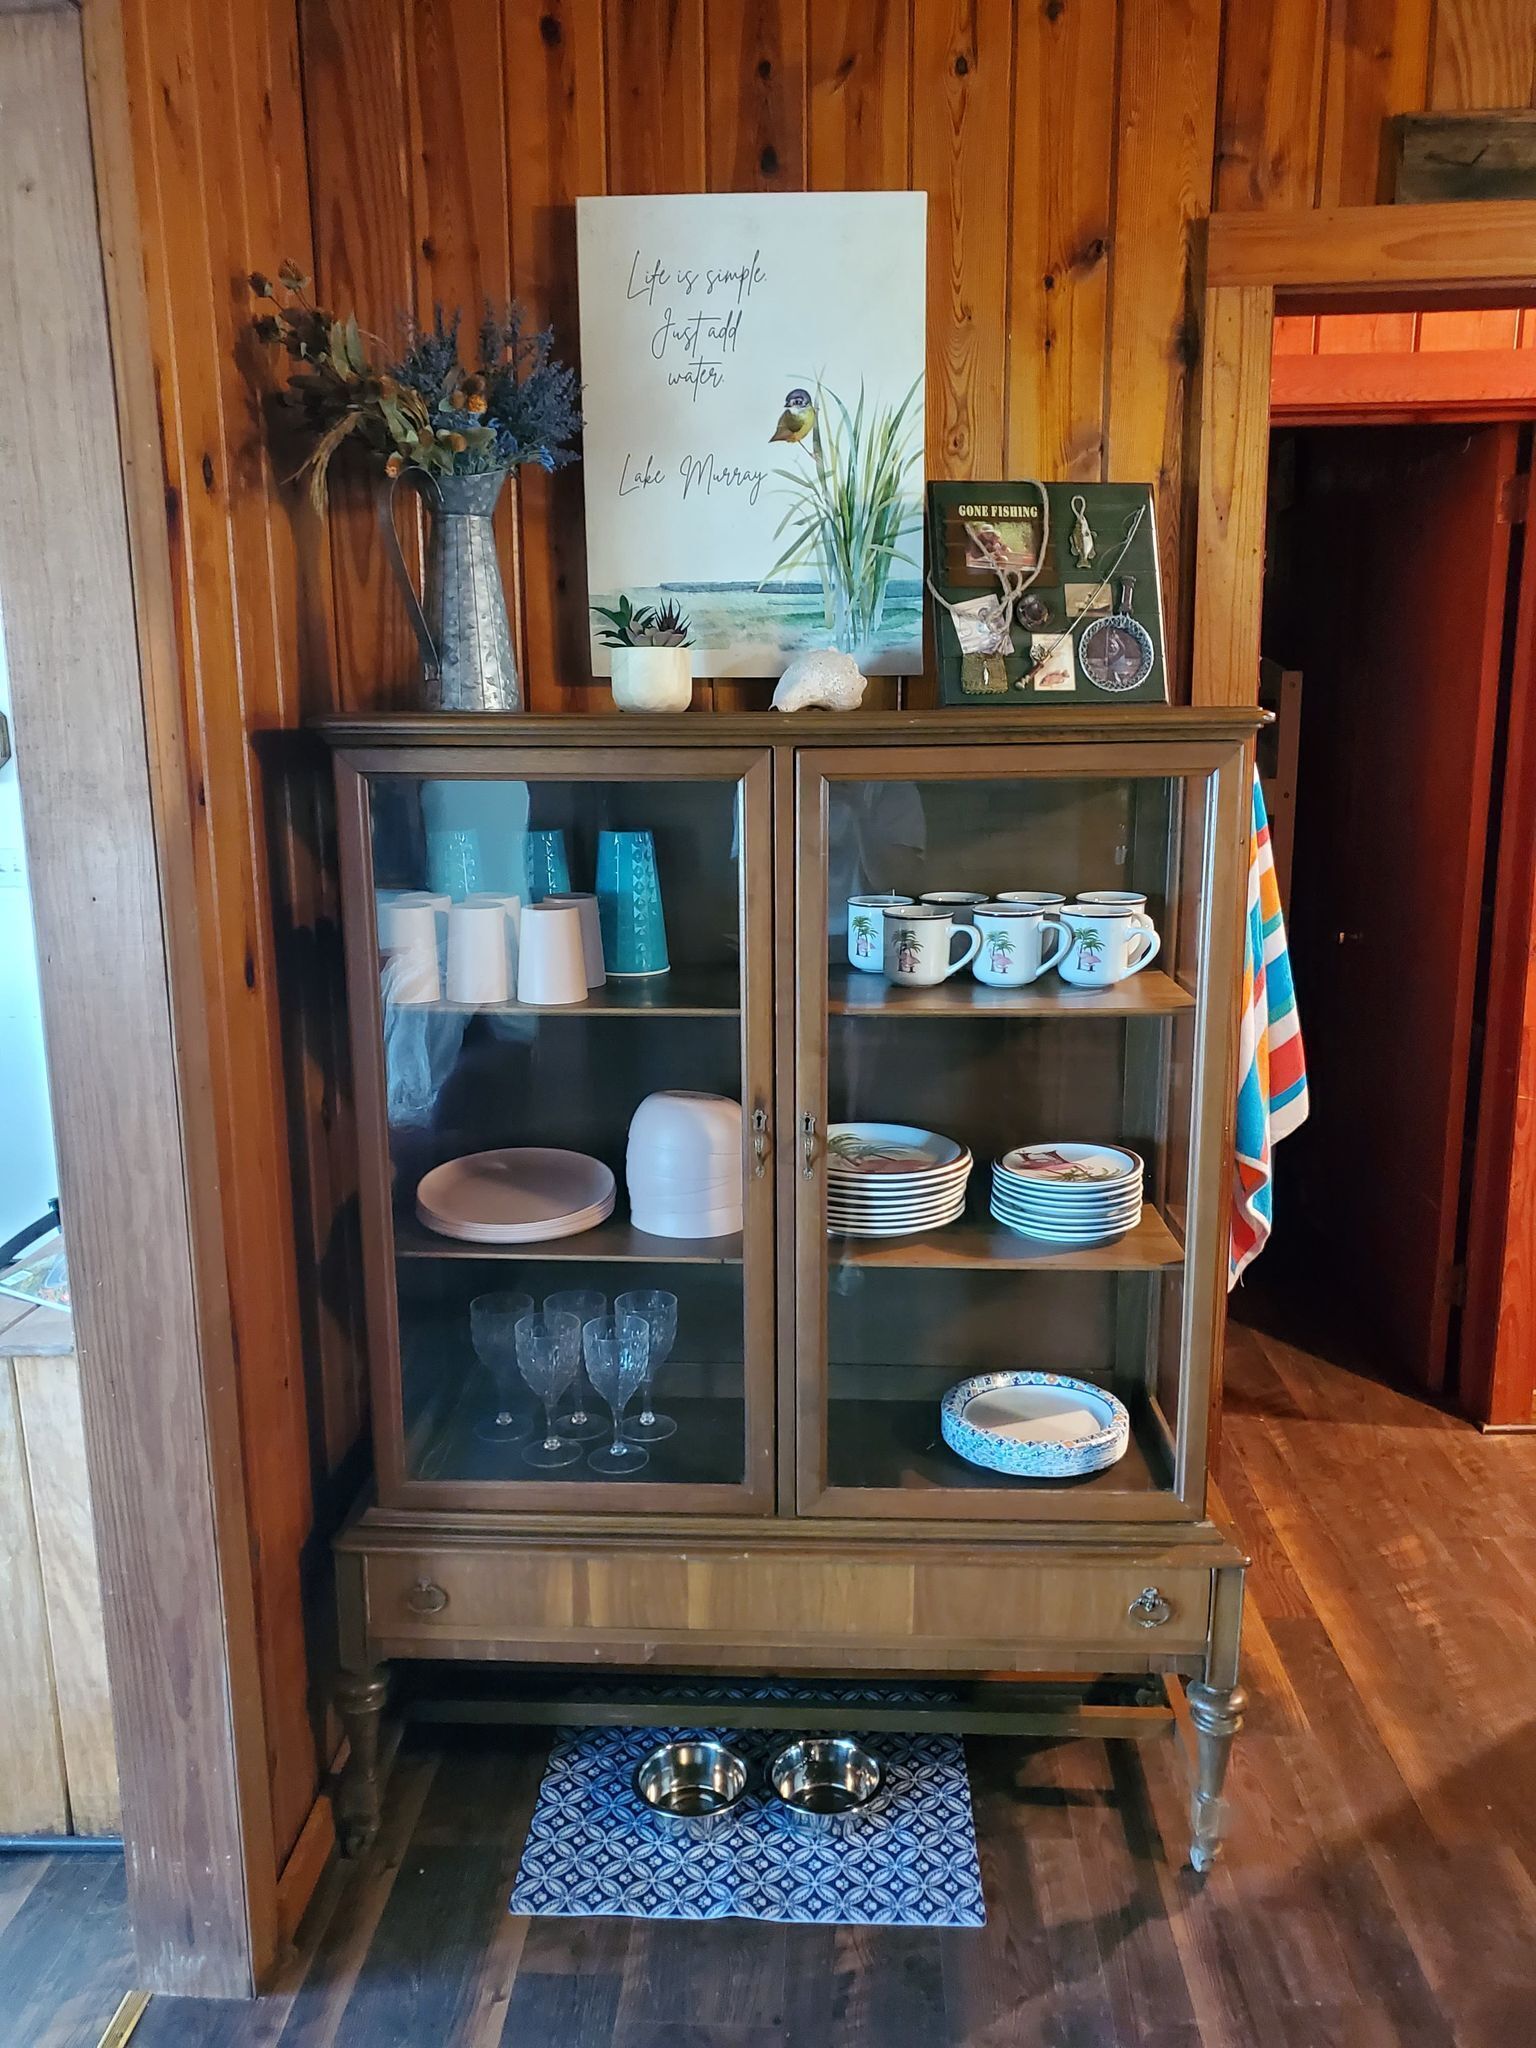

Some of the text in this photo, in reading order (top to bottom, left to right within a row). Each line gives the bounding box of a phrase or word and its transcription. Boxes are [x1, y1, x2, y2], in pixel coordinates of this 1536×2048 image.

[627, 249, 670, 306] Life
[677, 269, 699, 296] is
[651, 307, 743, 359] Just add
[619, 453, 768, 505] Lake Murray
[958, 505, 1038, 518] GONE FISHING
